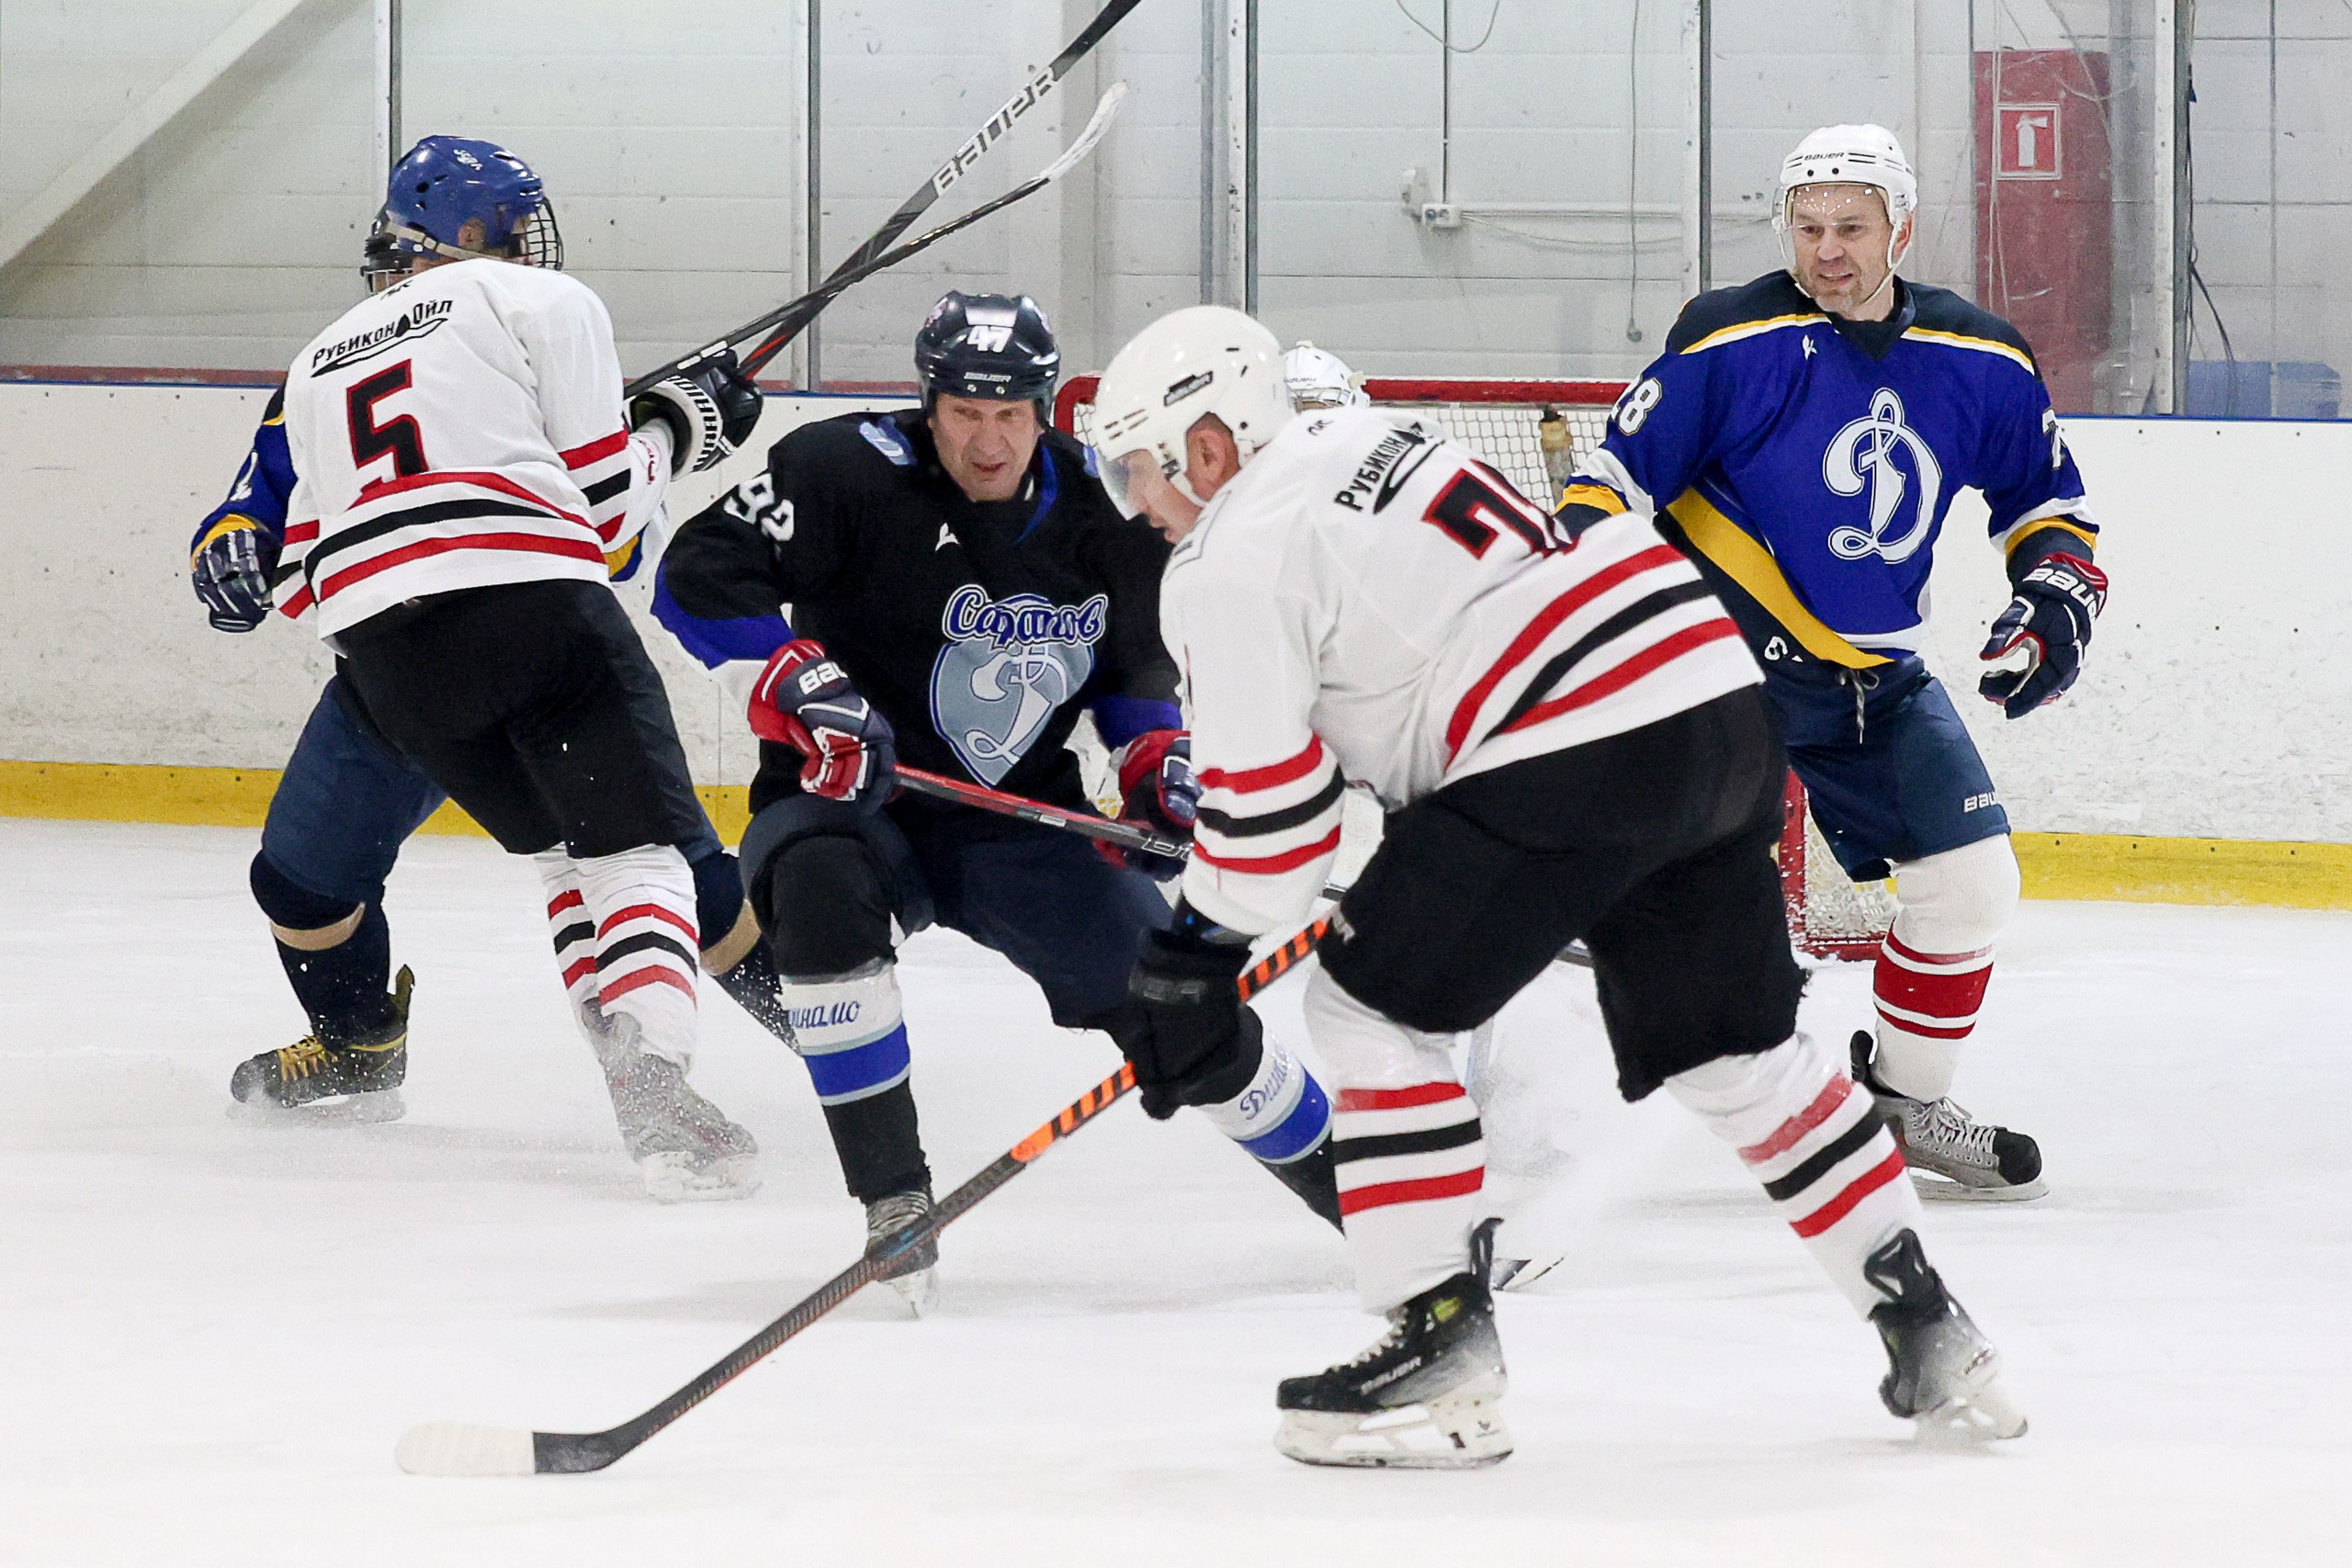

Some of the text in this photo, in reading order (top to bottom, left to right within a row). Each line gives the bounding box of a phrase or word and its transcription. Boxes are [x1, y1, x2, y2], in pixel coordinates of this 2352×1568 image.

[1804, 152, 1845, 161] BAUER
[346, 358, 430, 492] 5
[1611, 377, 1663, 436] 8
[1420, 458, 1562, 560] 7
